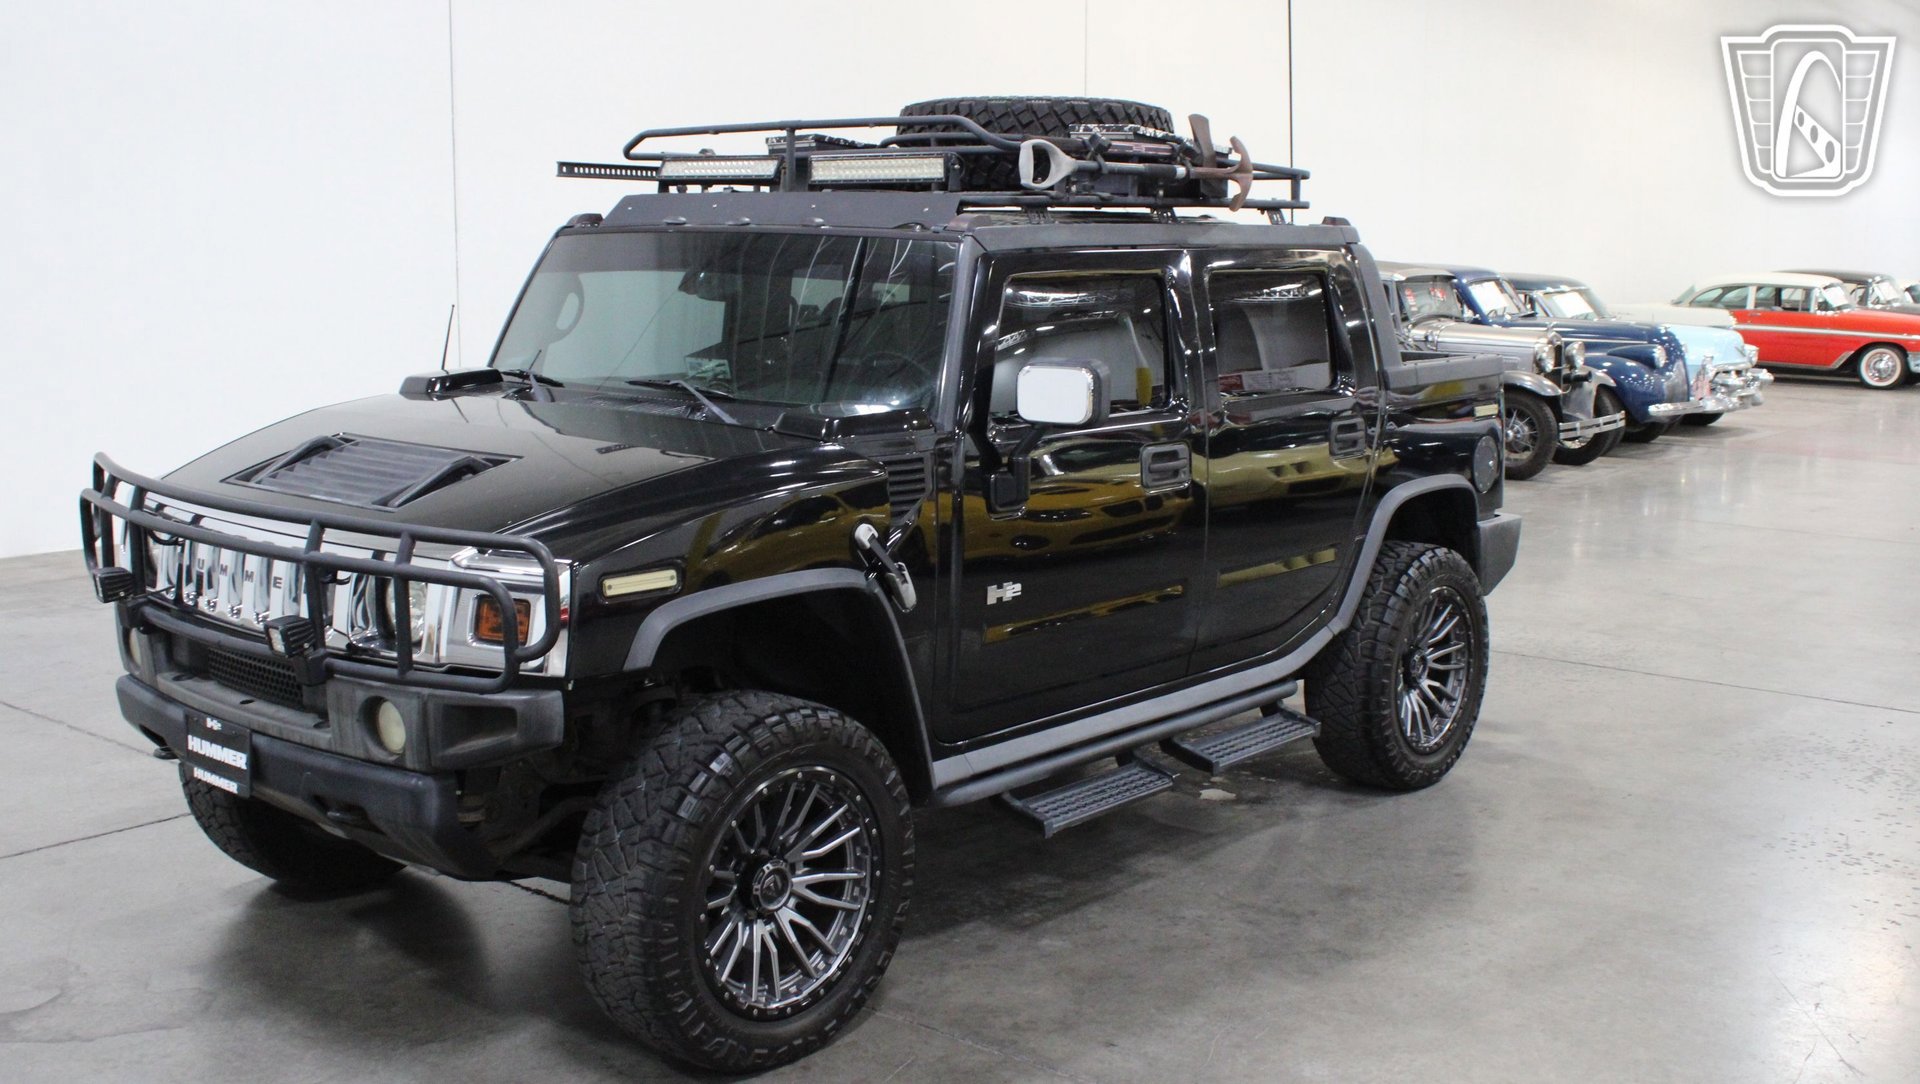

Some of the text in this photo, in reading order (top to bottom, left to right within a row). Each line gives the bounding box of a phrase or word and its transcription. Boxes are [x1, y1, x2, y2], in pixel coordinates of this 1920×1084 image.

[987, 581, 1022, 605] H2
[187, 734, 248, 770] HUMMER
[193, 767, 239, 794] HUMMER
